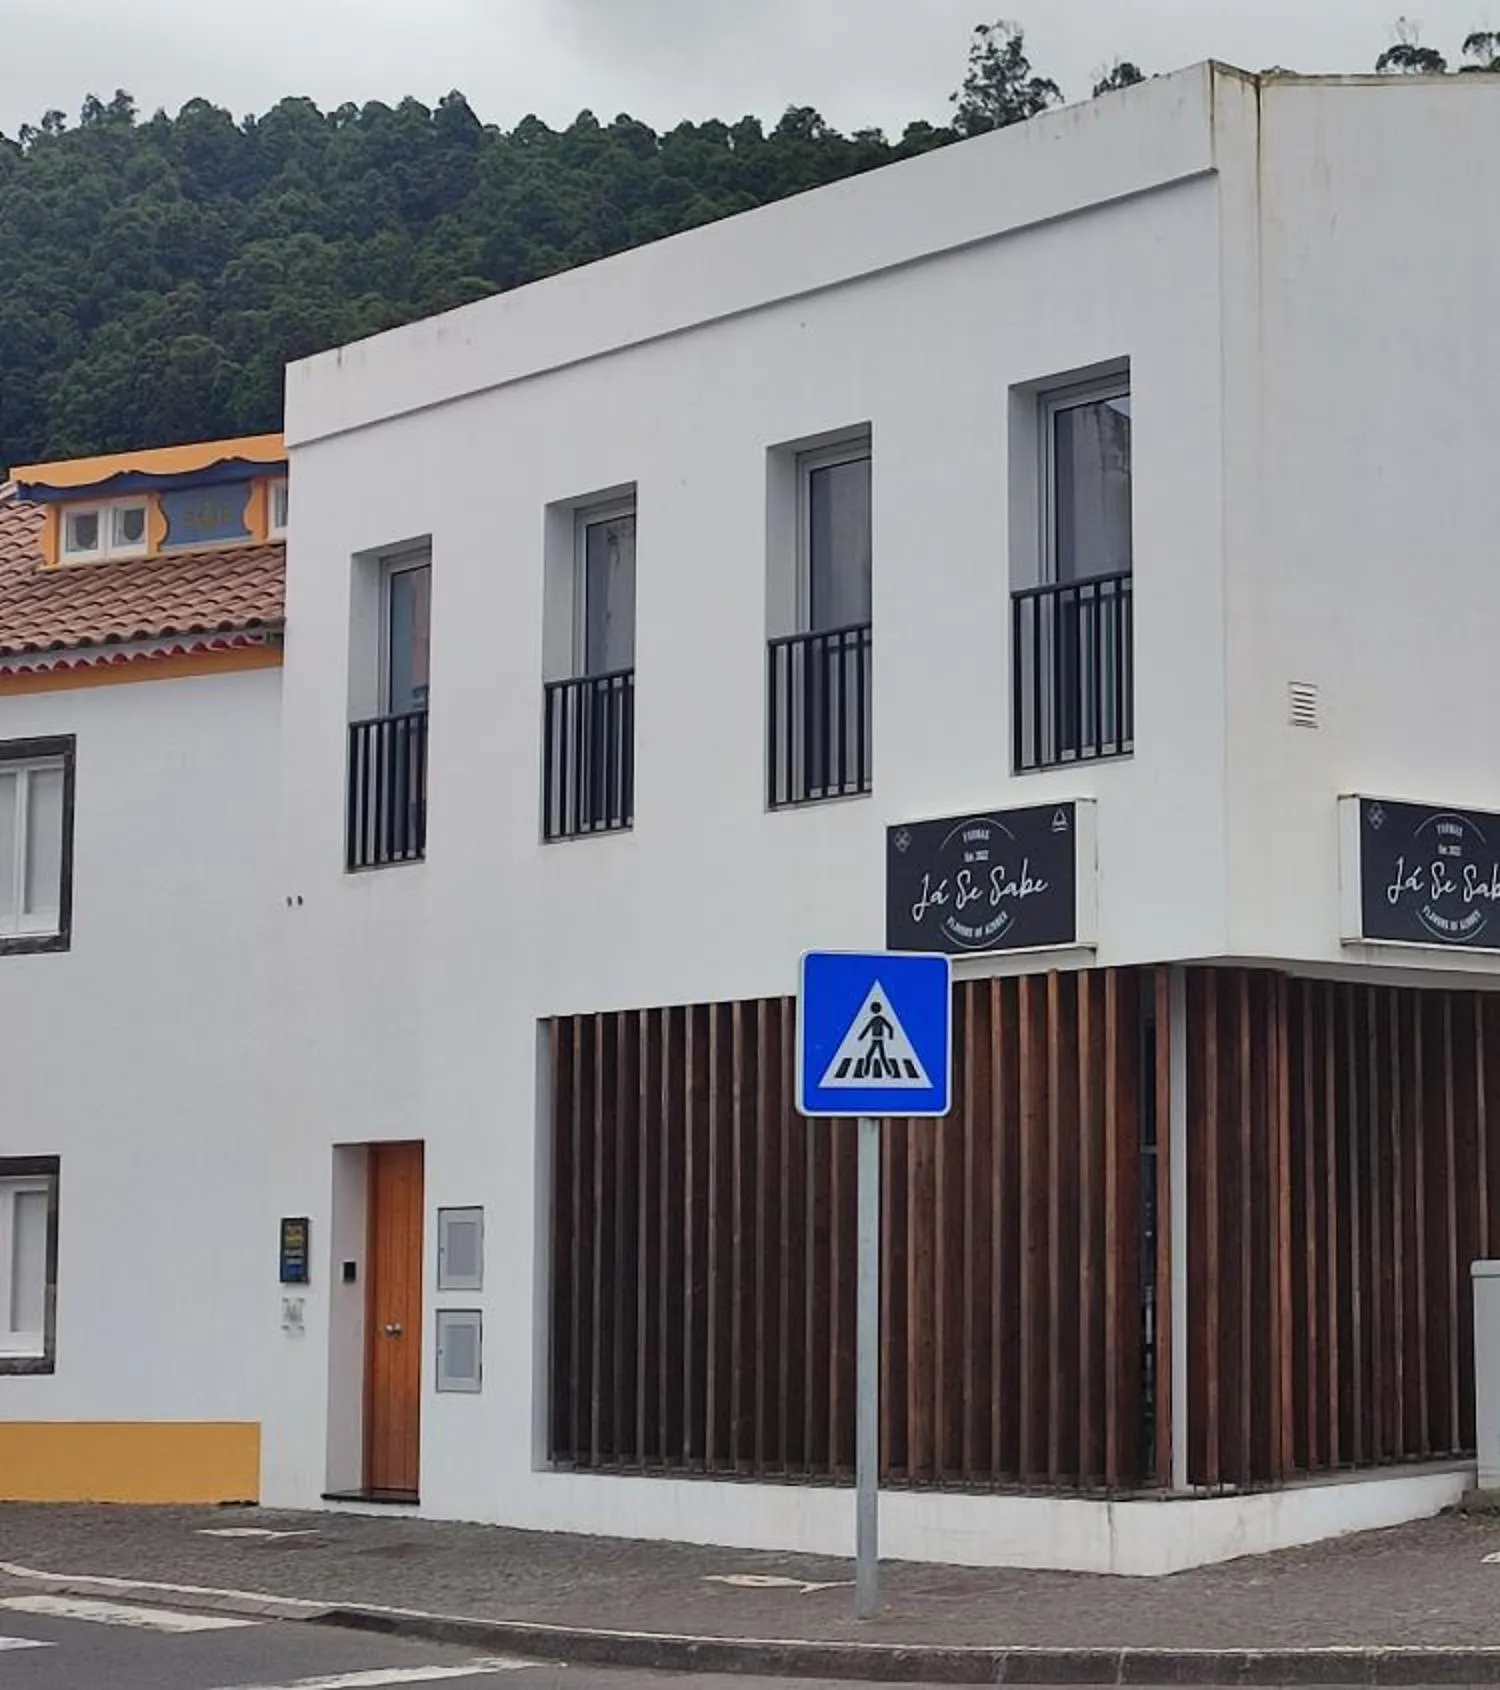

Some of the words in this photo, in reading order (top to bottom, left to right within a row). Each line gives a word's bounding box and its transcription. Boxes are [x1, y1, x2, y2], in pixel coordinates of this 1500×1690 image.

[912, 873, 950, 922] Já
[955, 870, 983, 910] Se
[990, 857, 1048, 906] Sabe
[1387, 856, 1424, 904] Já
[1431, 861, 1457, 900] Se
